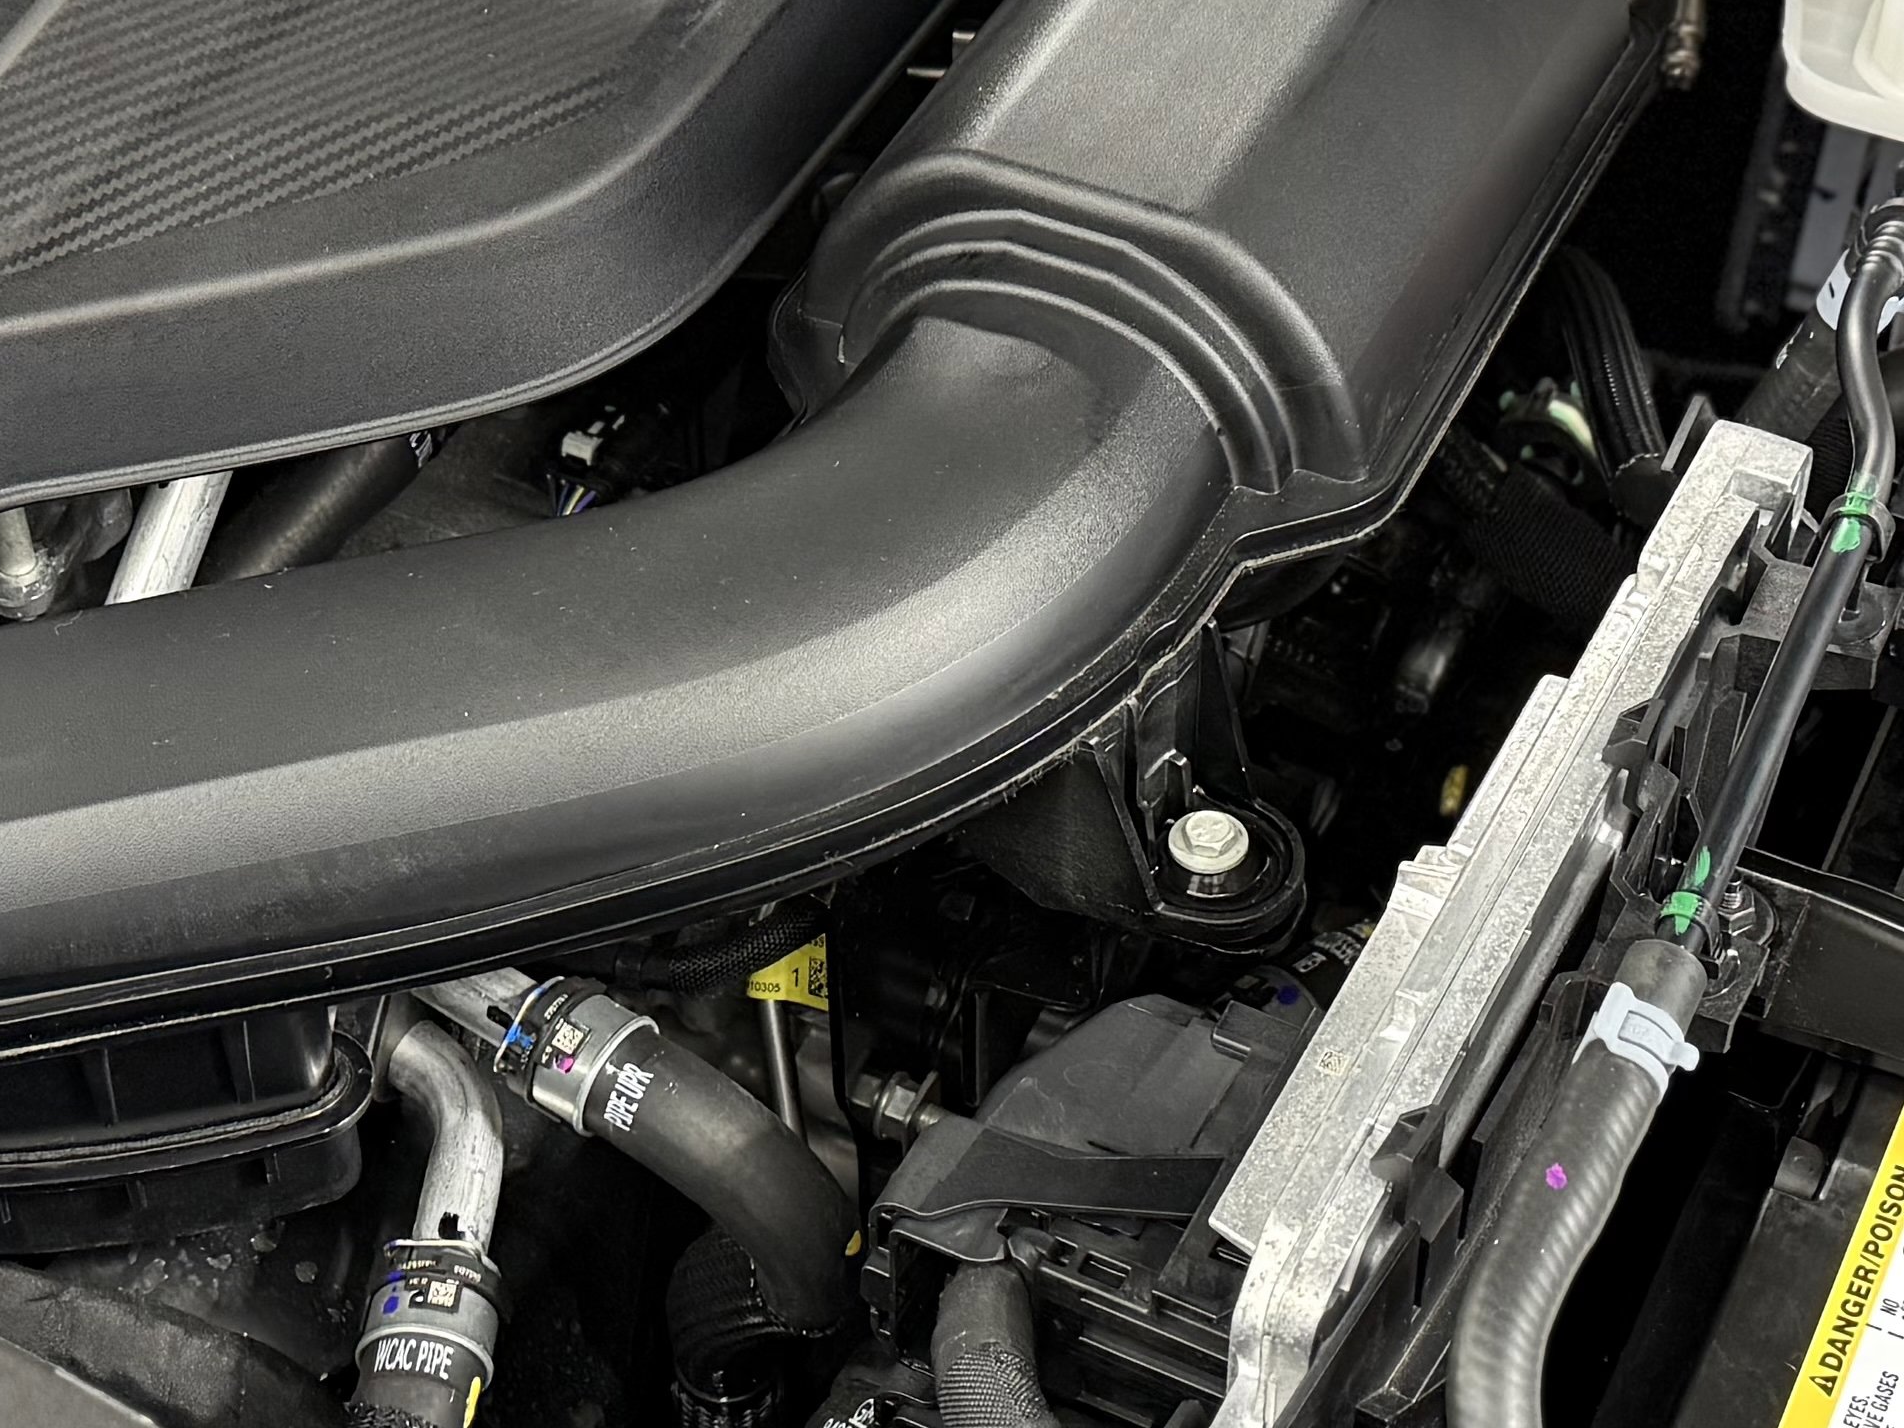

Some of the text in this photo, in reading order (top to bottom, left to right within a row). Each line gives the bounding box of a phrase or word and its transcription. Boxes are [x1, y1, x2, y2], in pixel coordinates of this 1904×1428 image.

[791, 967, 800, 988] 1
[603, 1062, 655, 1132] PIPE UPR
[1880, 1298, 1899, 1316] NO
[373, 1337, 455, 1380] WCAC PIPE
[1871, 1371, 1899, 1412] GASES
[1843, 1396, 1870, 1428] EYES.
